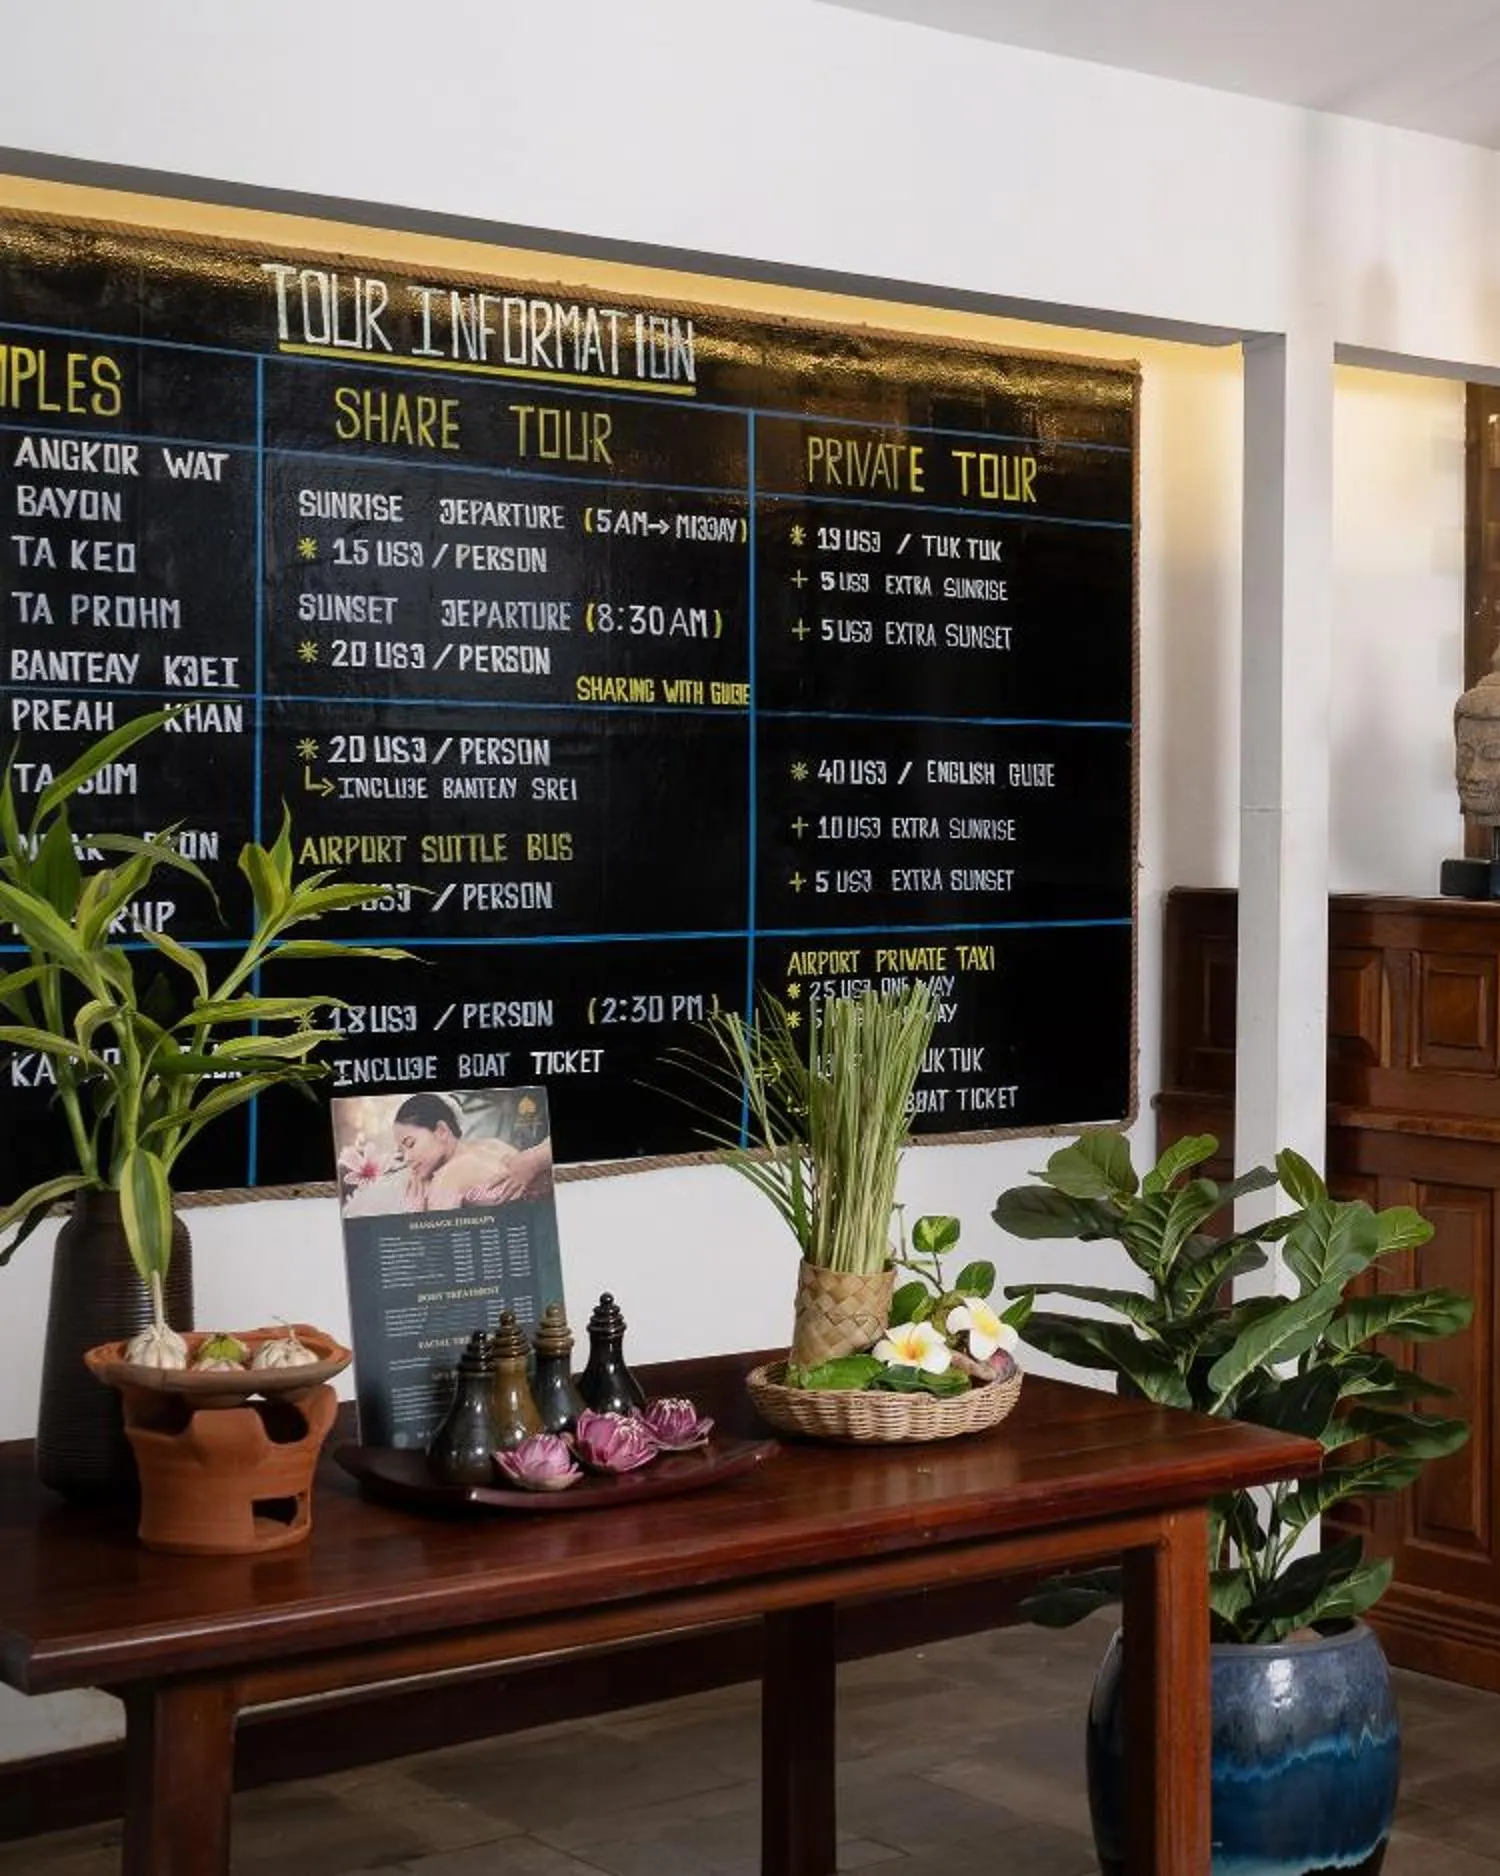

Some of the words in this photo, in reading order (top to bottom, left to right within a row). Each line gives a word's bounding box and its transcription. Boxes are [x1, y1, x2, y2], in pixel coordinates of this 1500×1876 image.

[261, 263, 393, 352] TOUR
[406, 284, 697, 383] INFORMATION
[334, 387, 461, 450] SHARE
[509, 404, 613, 465] TOUR
[14, 437, 140, 477] ANGKOR
[163, 449, 230, 482] WAT
[808, 436, 925, 493] PRIVATE
[951, 450, 1038, 503] TOUR
[17, 485, 122, 523] BAYON
[299, 489, 404, 523] SUNRISE
[439, 499, 565, 530] DEPARTURE
[11, 535, 55, 568] TA
[71, 540, 137, 573] KEO
[922, 534, 961, 559] TUK
[966, 538, 1002, 562] TUK
[885, 575, 932, 597] EXTRA
[943, 577, 1009, 601] SUNRISE
[11, 592, 54, 625] TA
[71, 594, 182, 630] PROHM
[299, 593, 399, 625] SUNSET
[441, 599, 571, 632] DEPARTURE
[885, 622, 937, 647] EXTRA
[945, 623, 1013, 651] SUNSET
[11, 649, 140, 684] BANTEAY
[576, 675, 655, 703] SHARING
[664, 678, 704, 704] WITH
[12, 699, 115, 732] PREAH
[163, 702, 243, 733] KHAN
[13, 763, 55, 794] TA
[76, 763, 138, 795] SOM
[338, 776, 428, 799] INCLUDE
[443, 777, 517, 799] BANTEAY
[531, 778, 578, 801] SREI
[927, 760, 995, 785] ENGLISH
[891, 816, 940, 839] EXTRA
[950, 819, 1017, 842] SUNRISE
[299, 834, 407, 865] AIRPORT
[421, 832, 509, 863] SUTTLE
[527, 832, 574, 861] BUS
[891, 869, 943, 892] EXTRA
[951, 869, 1016, 892] SUNSET
[787, 949, 861, 977] AIRPORT
[875, 946, 948, 974] PRIVATE
[955, 945, 995, 972] TAXI
[333, 1055, 438, 1086] INCLUDE
[459, 1051, 511, 1079] BOAT
[530, 1049, 606, 1075] TICKET
[920, 1048, 946, 1074] UK
[949, 1047, 985, 1073] TUK
[905, 1088, 951, 1113] BOAT
[955, 1085, 1019, 1112] TICKET
